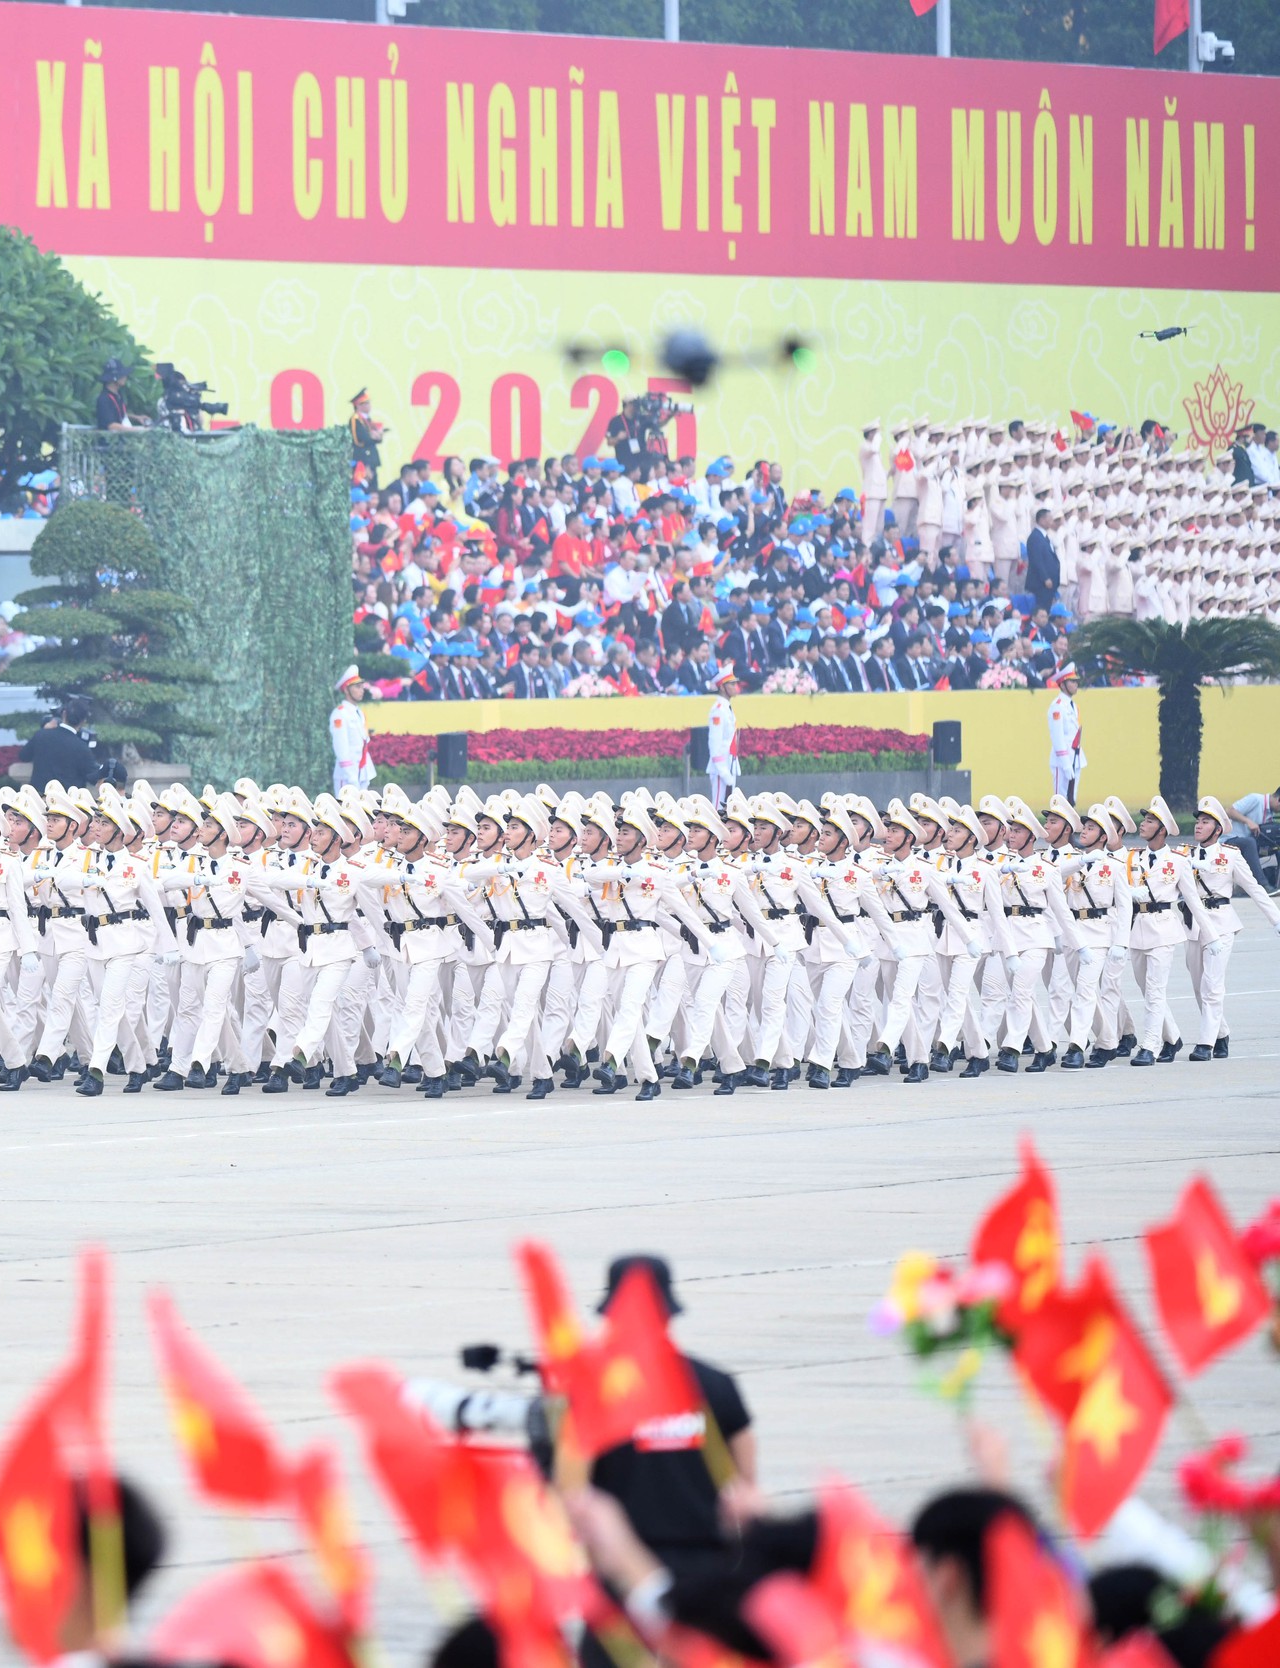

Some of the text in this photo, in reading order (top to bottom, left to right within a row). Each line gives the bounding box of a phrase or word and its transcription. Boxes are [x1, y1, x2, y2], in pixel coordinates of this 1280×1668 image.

[36, 39, 111, 209] XÃ
[149, 42, 253, 242] HỘI
[292, 43, 409, 223] CHỦ
[446, 67, 624, 229] NGHĨA
[656, 72, 776, 260] VIỆT
[809, 100, 917, 239] NAM
[951, 89, 1093, 245] MUÔN
